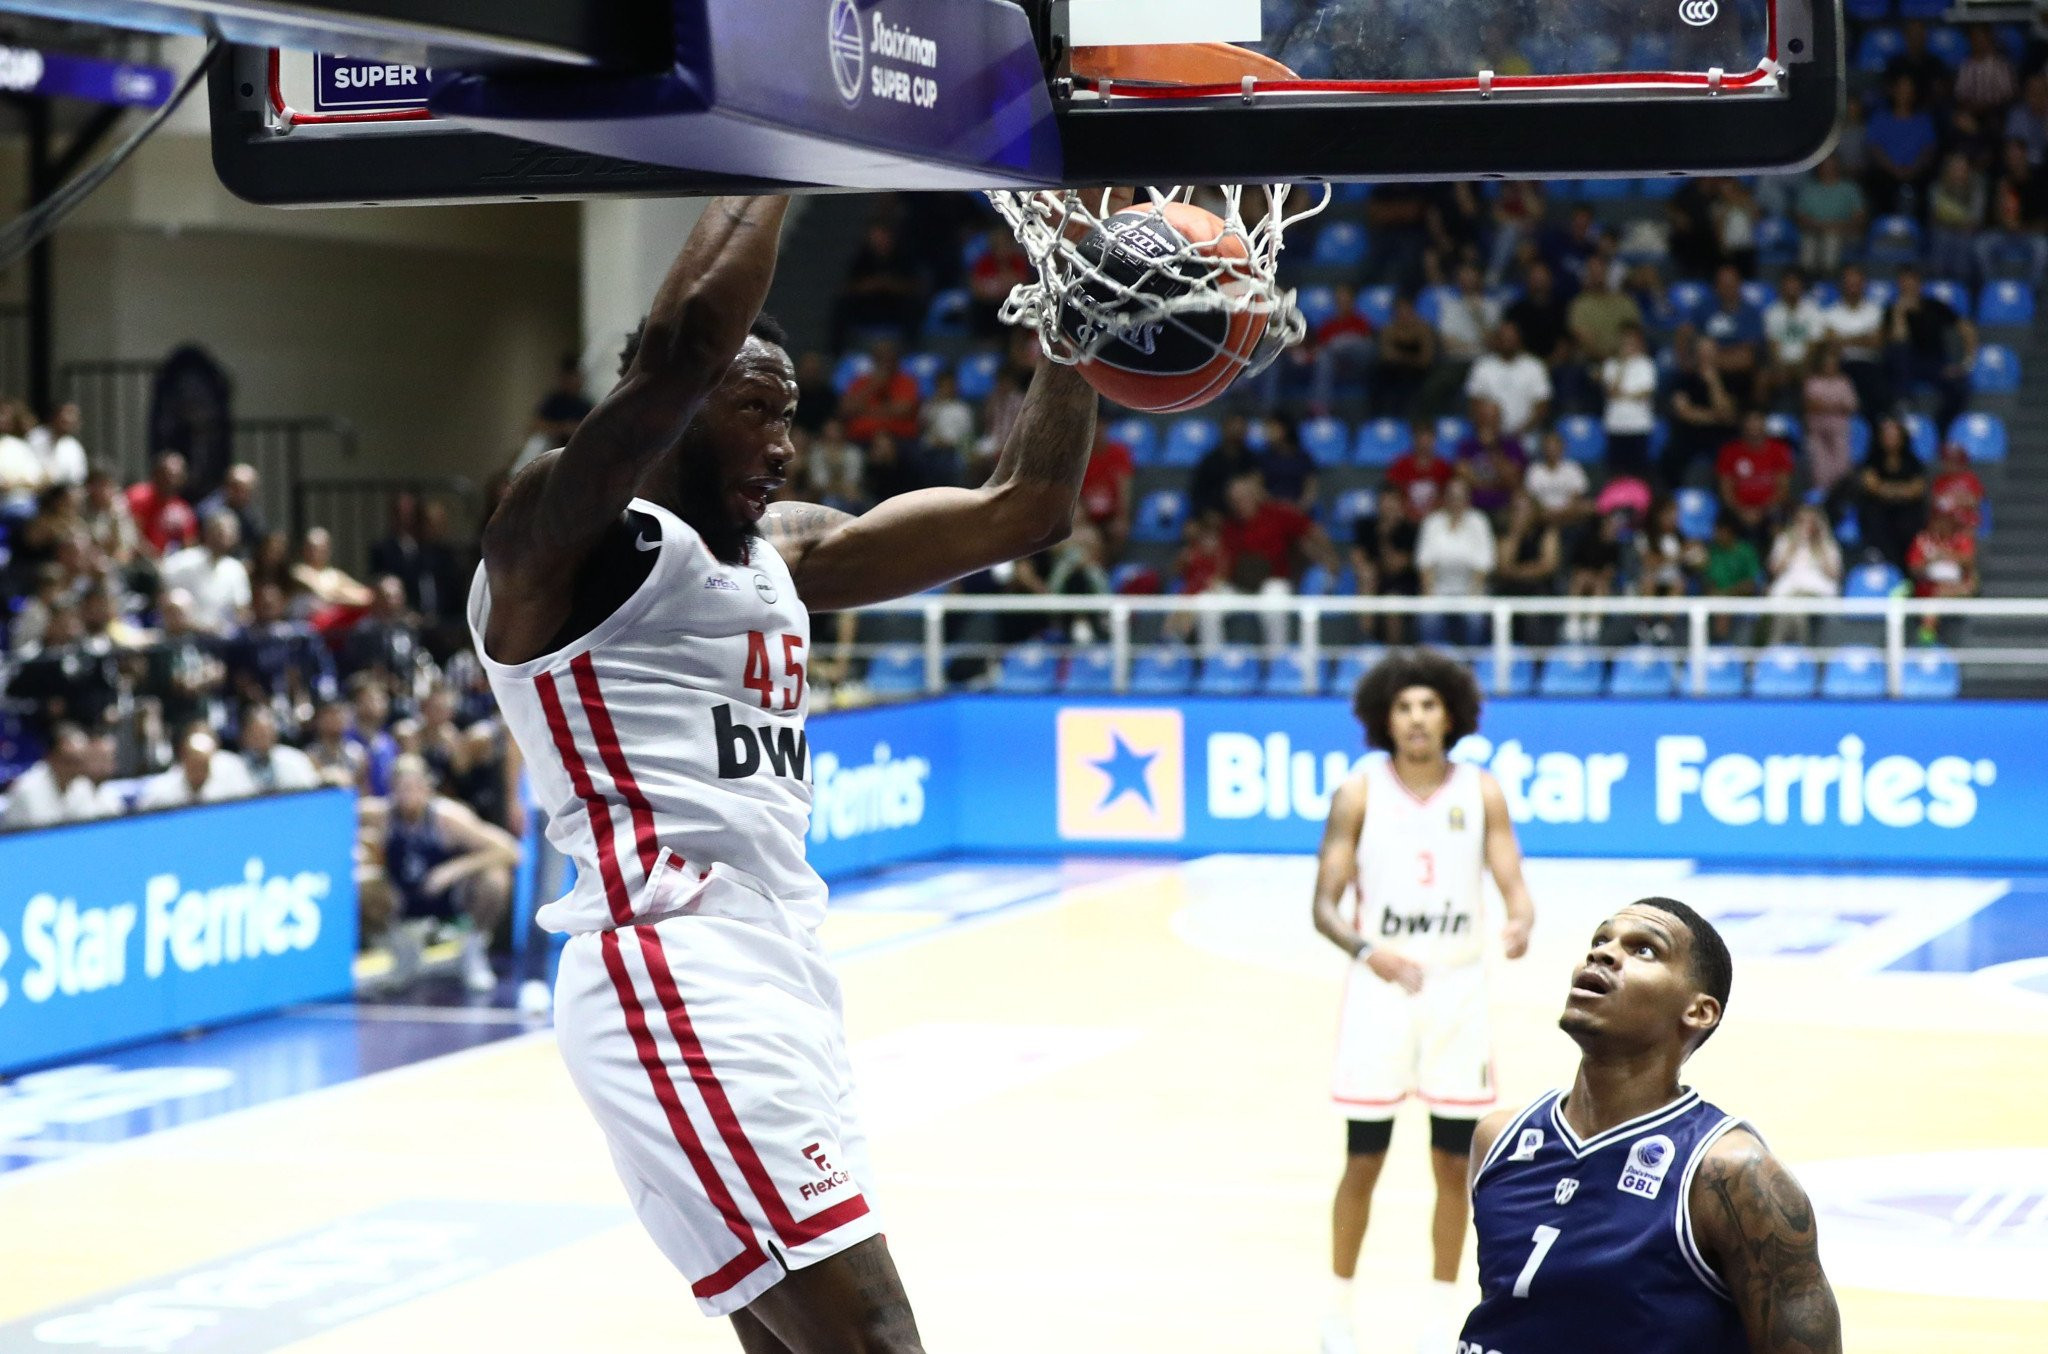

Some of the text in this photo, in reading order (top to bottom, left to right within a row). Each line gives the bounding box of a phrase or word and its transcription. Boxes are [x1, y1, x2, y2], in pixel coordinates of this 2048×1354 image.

[870, 10, 937, 69] Stoiximan
[334, 64, 418, 89] SUPER
[871, 65, 938, 109] SUPER CUP
[743, 630, 804, 710] 45
[711, 703, 813, 785] bw
[1655, 733, 1980, 828] Ferries
[1418, 850, 1435, 886] 3
[21, 893, 137, 1003] Star
[144, 857, 325, 979] Ferries
[799, 1170, 850, 1201] FlexCa
[1623, 1175, 1654, 1195] GBL
[1512, 1224, 1561, 1298] 1
